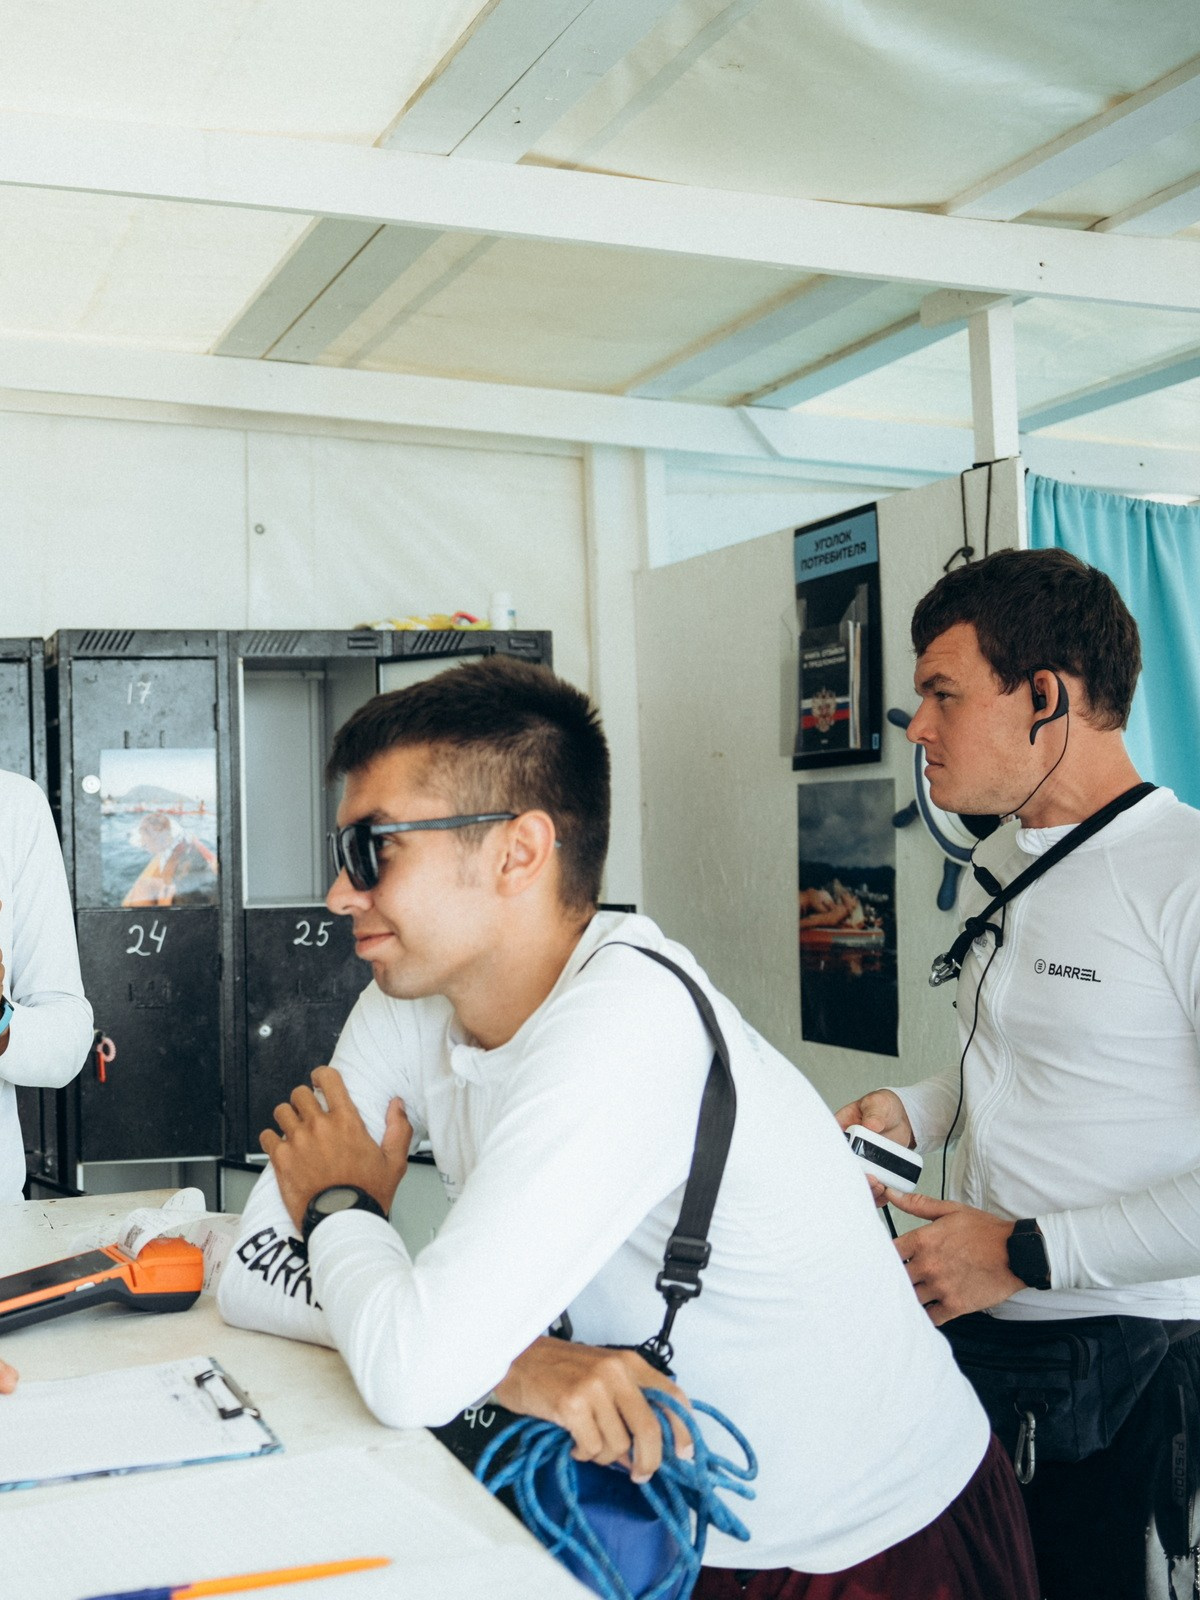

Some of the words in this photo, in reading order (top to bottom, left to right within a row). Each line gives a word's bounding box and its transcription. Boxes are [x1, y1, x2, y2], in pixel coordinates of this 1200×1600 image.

[814, 529, 852, 552] УГОЛОК
[801, 541, 867, 571] ПОТРЕБИТЕЛЯ
[127, 681, 152, 705] 17
[126, 919, 168, 957] 24
[293, 920, 334, 947] 25
[1048, 963, 1102, 983] BARREL
